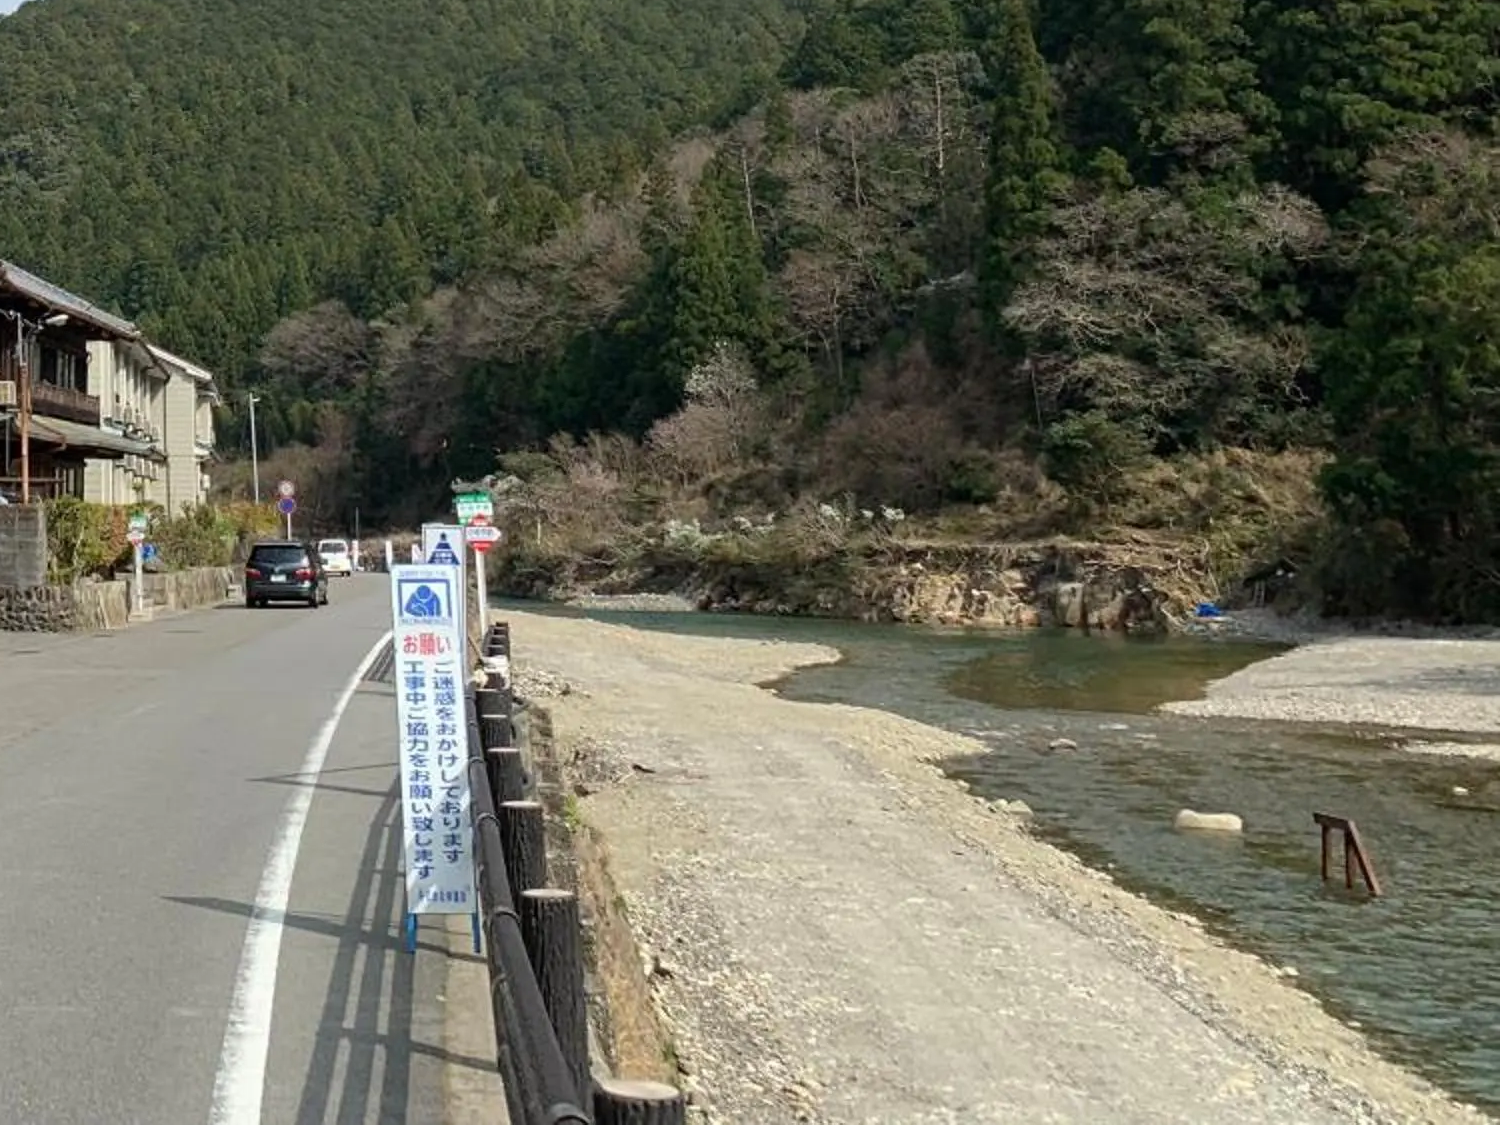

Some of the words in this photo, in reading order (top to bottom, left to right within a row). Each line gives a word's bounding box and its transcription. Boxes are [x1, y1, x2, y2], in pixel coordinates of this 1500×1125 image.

[403, 633, 451, 655] お願い
[403, 660, 435, 879] 工事中ご協力をお願い致します
[432, 660, 464, 863] ご迷惑をおかけしております
